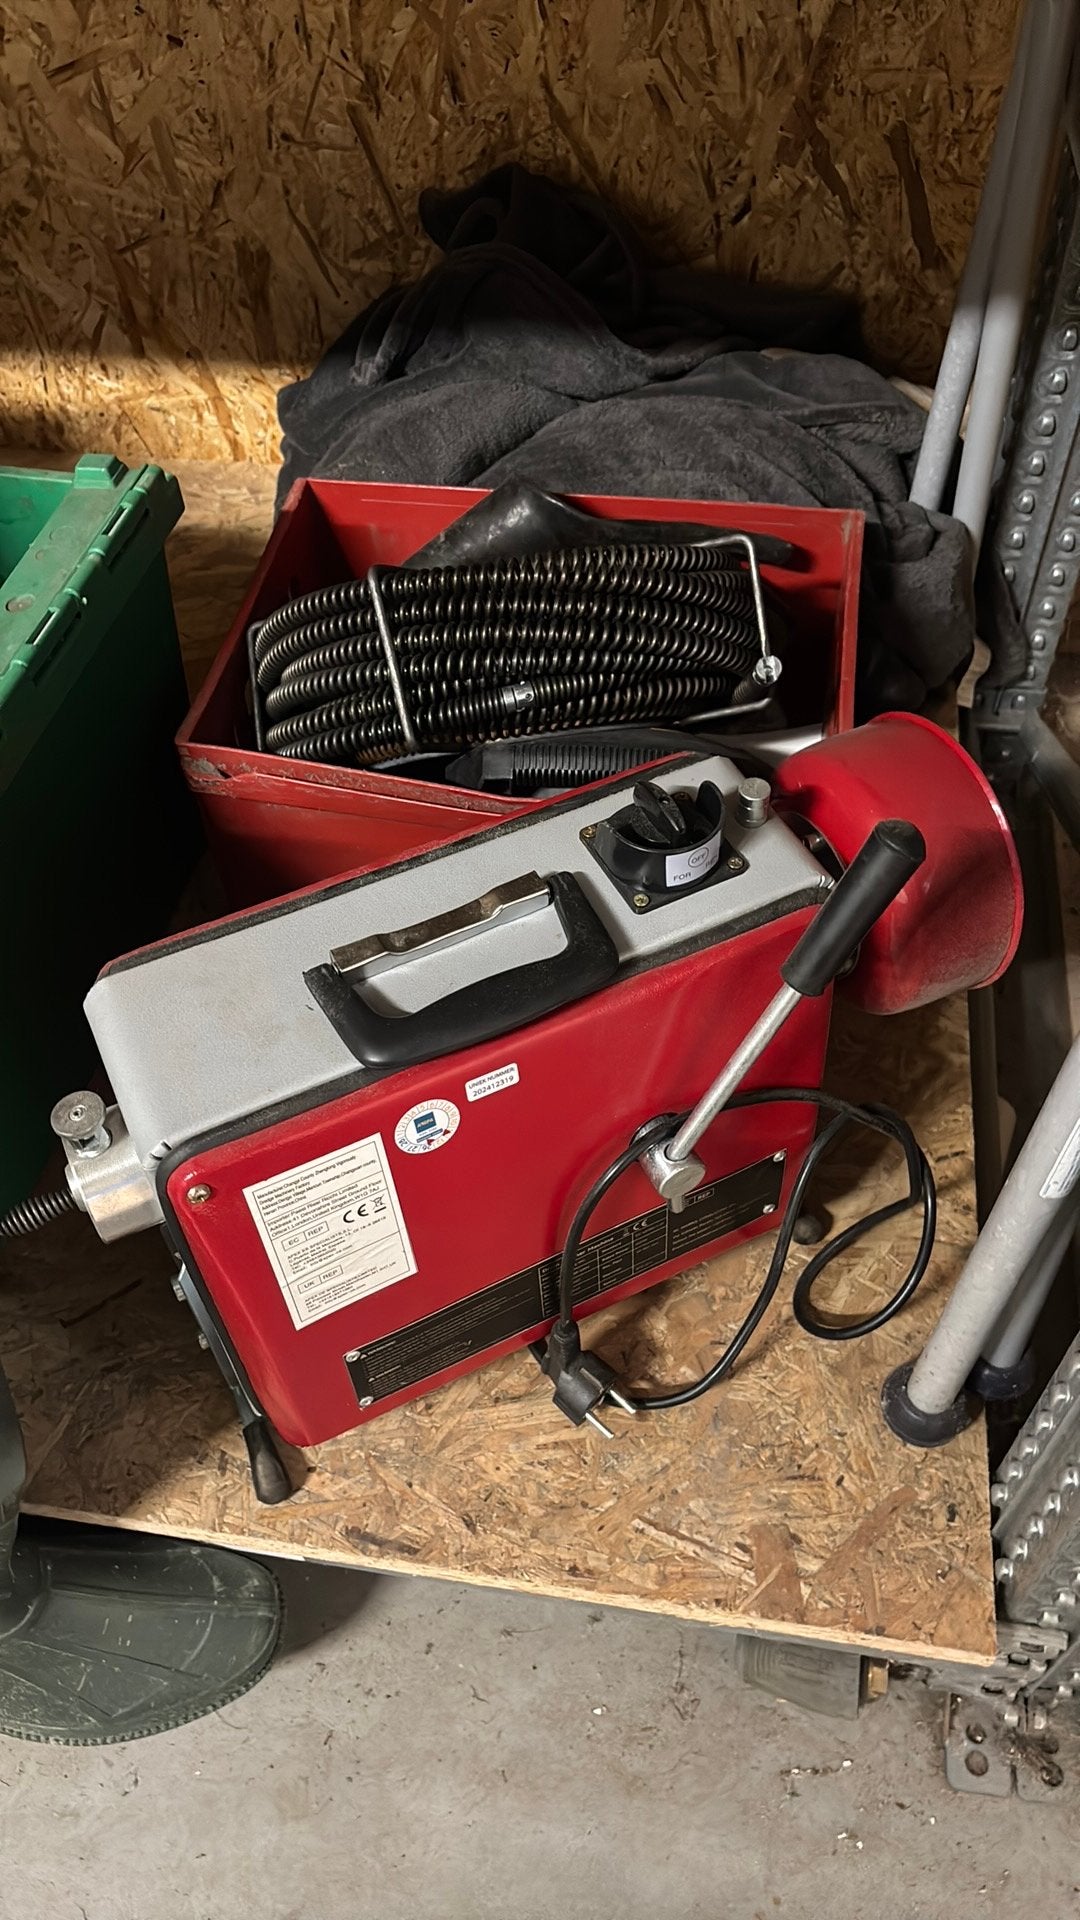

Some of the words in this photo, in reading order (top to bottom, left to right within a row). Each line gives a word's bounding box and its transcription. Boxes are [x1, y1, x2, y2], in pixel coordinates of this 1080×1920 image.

[691, 853, 706, 864] OFF
[673, 872, 691, 881] FOR
[468, 1079, 487, 1090] UNIEK
[487, 1066, 515, 1082] NUMMER
[472, 1075, 514, 1097] 202412319
[307, 1226, 323, 1236] REP
[288, 1237, 299, 1245] EC
[322, 1269, 338, 1279] REP
[304, 1280, 314, 1288] UK
